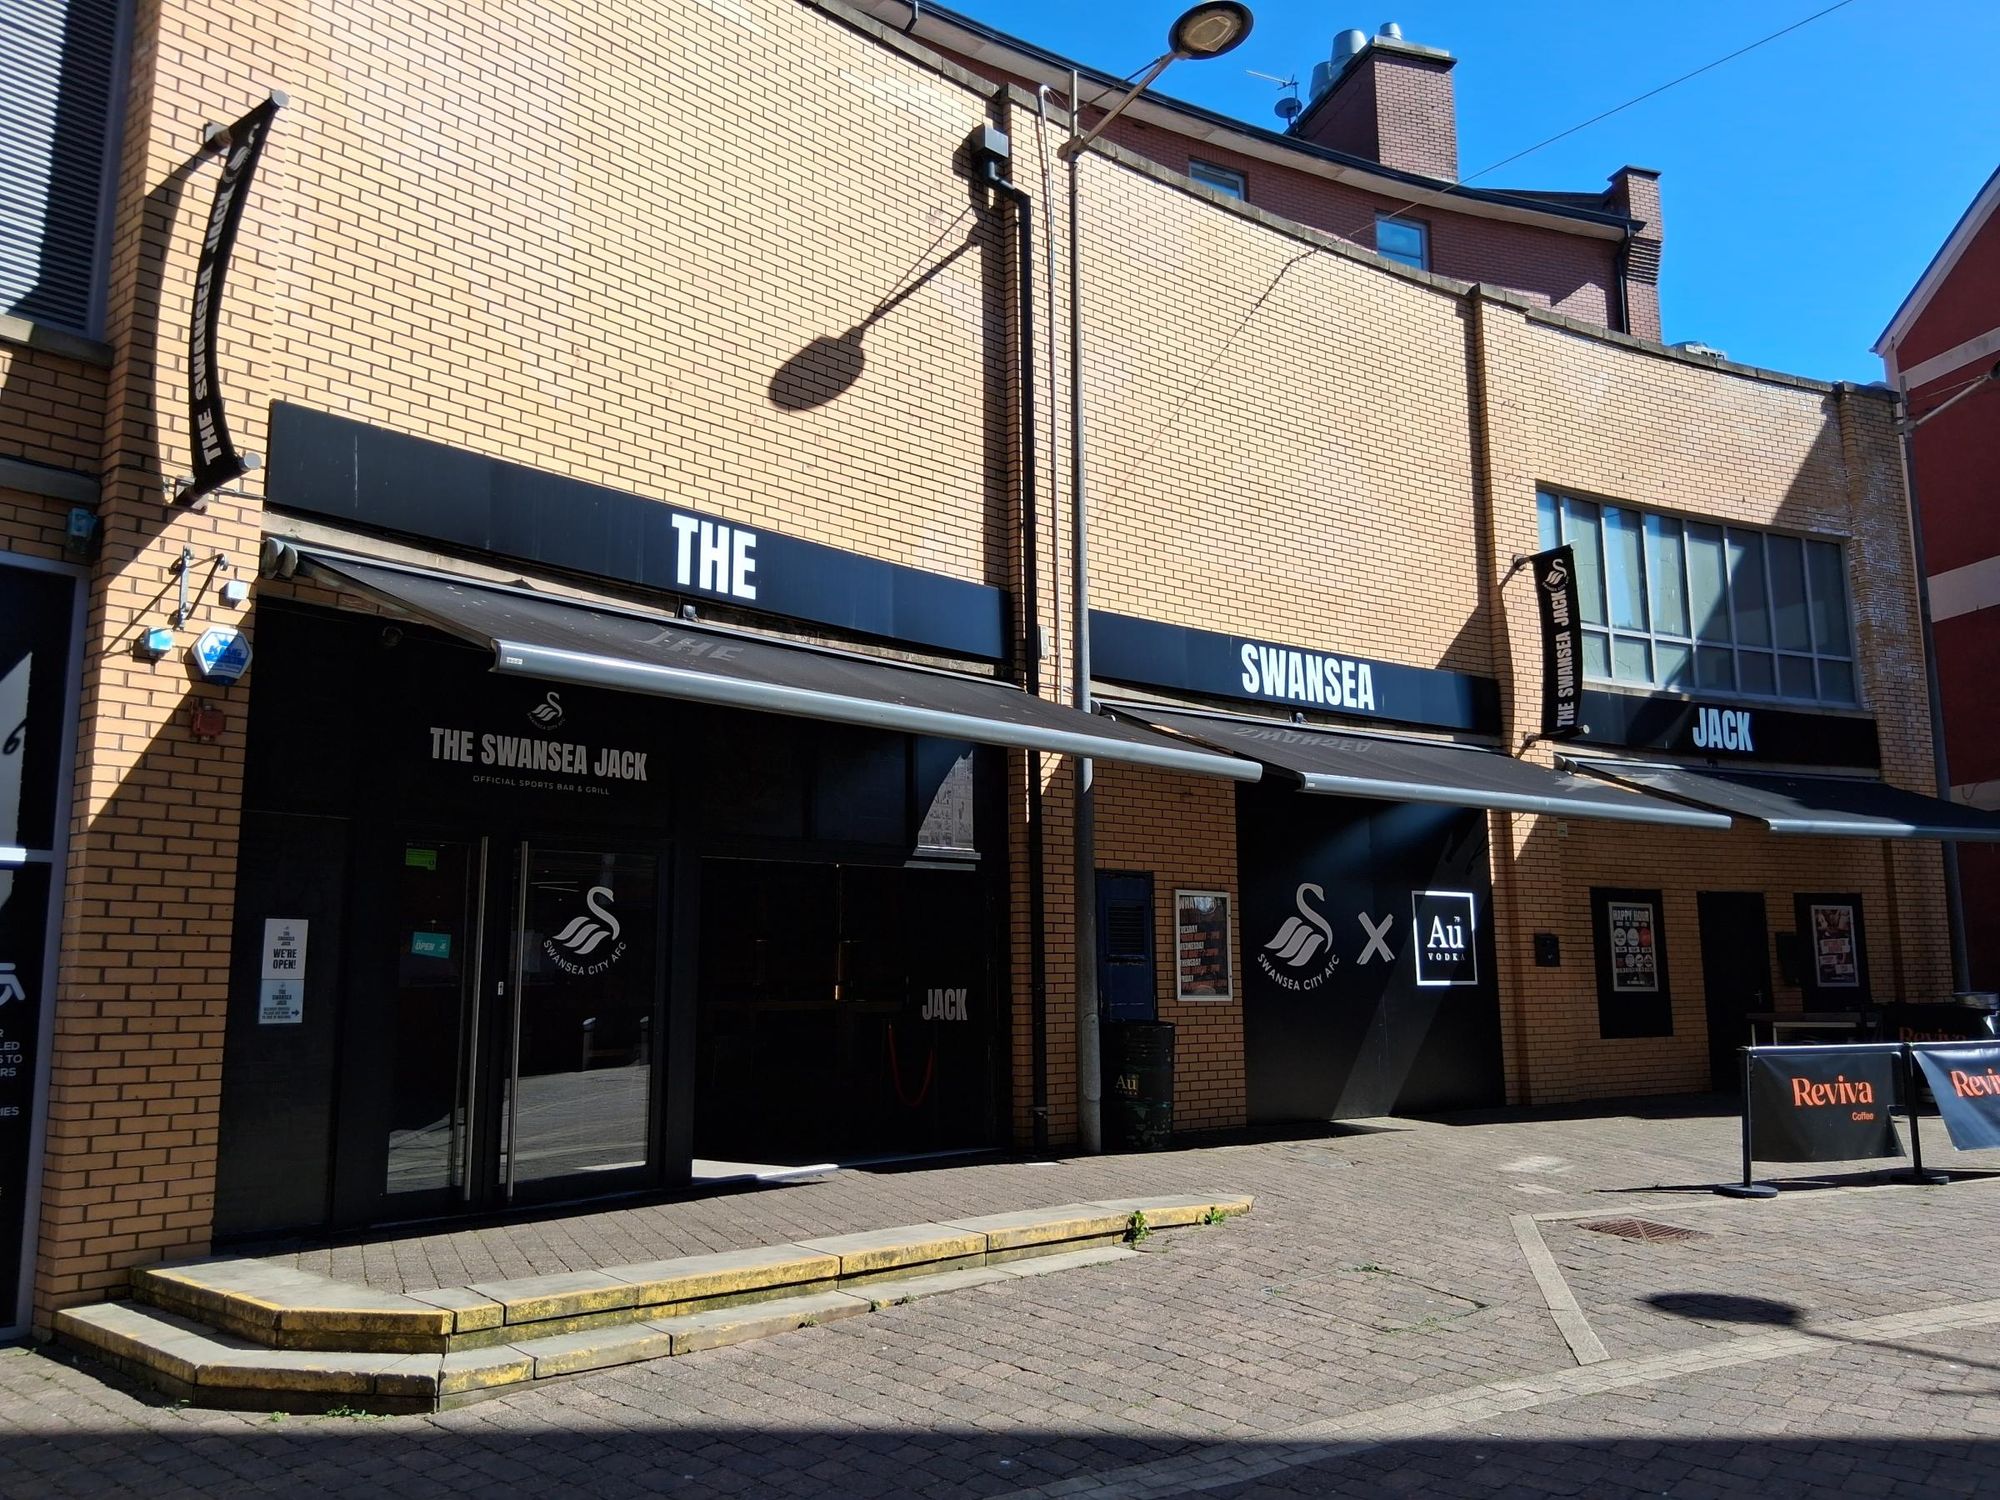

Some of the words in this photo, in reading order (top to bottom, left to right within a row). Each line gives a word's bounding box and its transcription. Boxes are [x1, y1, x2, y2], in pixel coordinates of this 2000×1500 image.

[205, 184, 236, 253] JACK
[195, 262, 214, 400] SWANSEA
[198, 408, 222, 466] THE
[672, 513, 756, 600] THE
[1551, 590, 1570, 627] JACK
[1241, 644, 1374, 710] SWANSEA
[1556, 630, 1574, 698] SWANSEA
[1557, 702, 1574, 728] THE
[1692, 708, 1754, 752] JACK
[430, 726, 474, 762] THE
[481, 734, 588, 774] SWANSEA
[594, 748, 648, 781] JACK
[472, 775, 516, 786] OFFICIAL
[519, 780, 554, 790] SPORTS
[557, 783, 574, 792] BAR
[577, 785, 582, 793] &
[586, 786, 610, 796] GRILL
[1427, 916, 1464, 948] Au
[272, 959, 296, 969] OPEN!
[273, 948, 297, 958] WE'RE
[544, 940, 584, 975] SWANSEA
[588, 960, 609, 975] CITY
[611, 942, 626, 962] AFC
[1428, 952, 1465, 961] VODKA
[1257, 954, 1300, 990] SWANSEA
[1304, 976, 1323, 990] CITY
[1325, 954, 1340, 978] AFC
[922, 988, 968, 1020] JACK
[1114, 1074, 1137, 1090] Au
[1791, 1074, 1873, 1107] Reviva
[1852, 1112, 1874, 1121] Coffee
